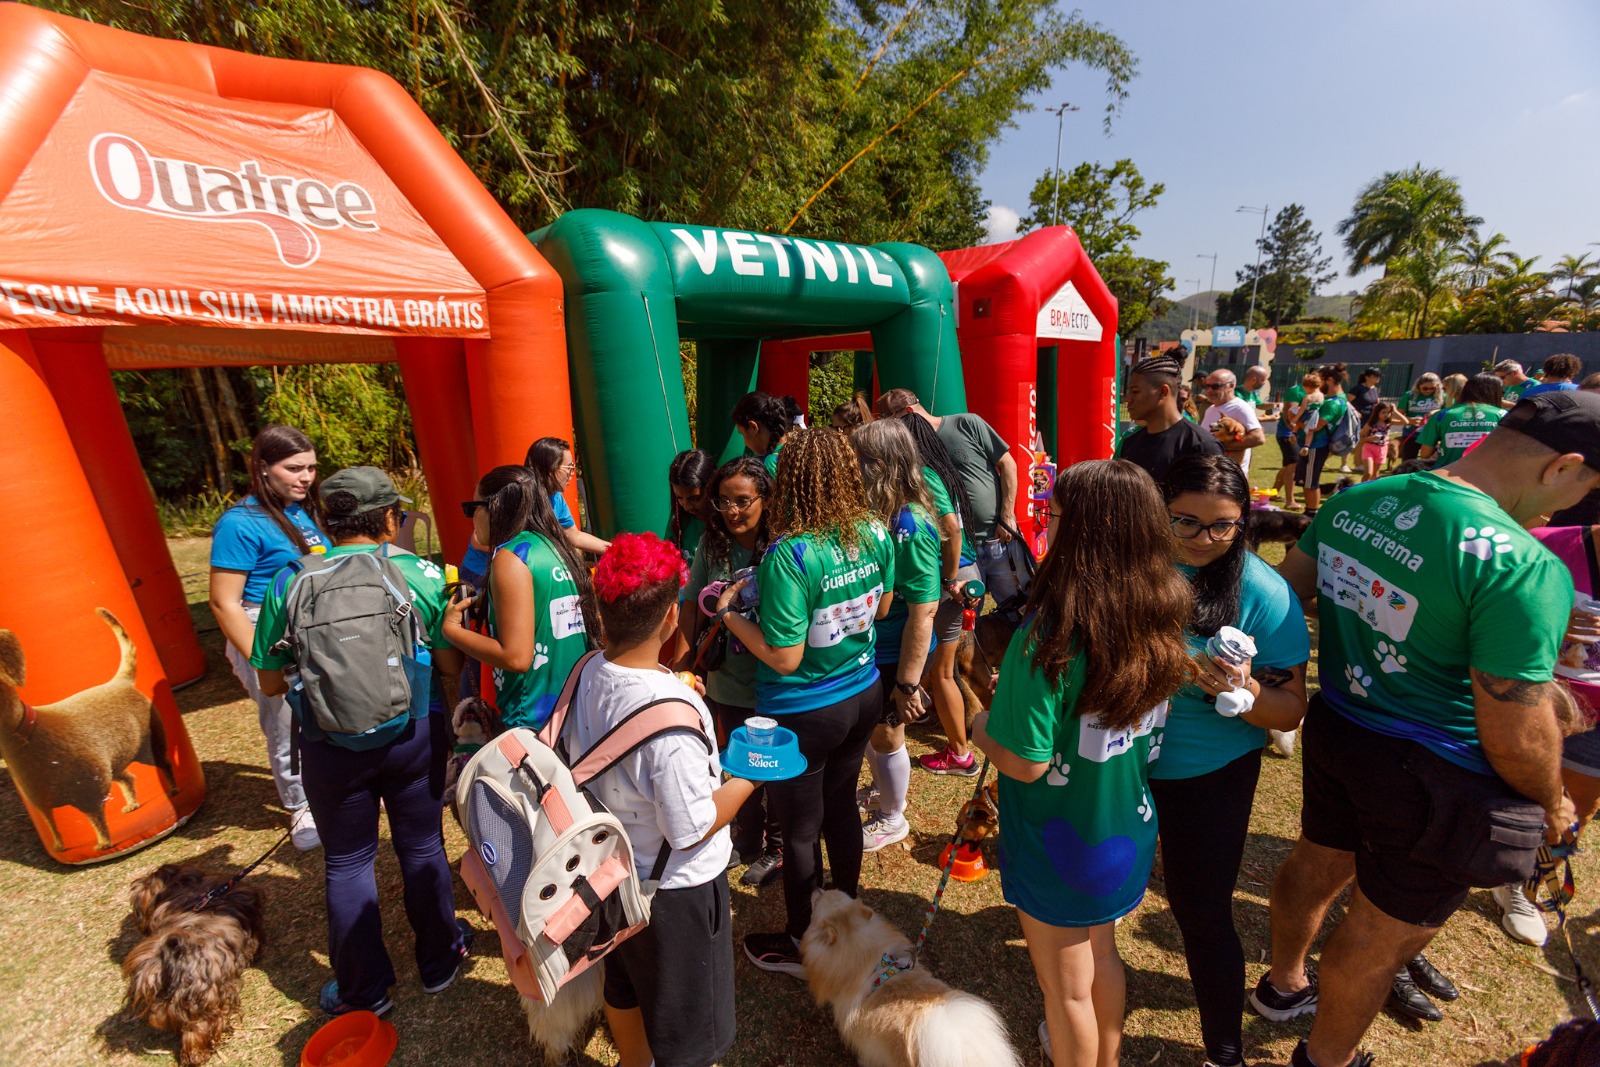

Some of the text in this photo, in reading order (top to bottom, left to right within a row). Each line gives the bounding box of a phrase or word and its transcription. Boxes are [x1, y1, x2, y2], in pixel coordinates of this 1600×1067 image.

[88, 132, 380, 268] Quatree
[0, 281, 485, 329] EGUE AQUI SUA AMOSTRA GRÁTIS
[1050, 307, 1089, 331] BRAVECTO
[1332, 510, 1424, 573] Guararema
[1355, 512, 1409, 543] PREFEITURA DE
[821, 561, 880, 592] Guararema
[748, 759, 778, 768] Select
